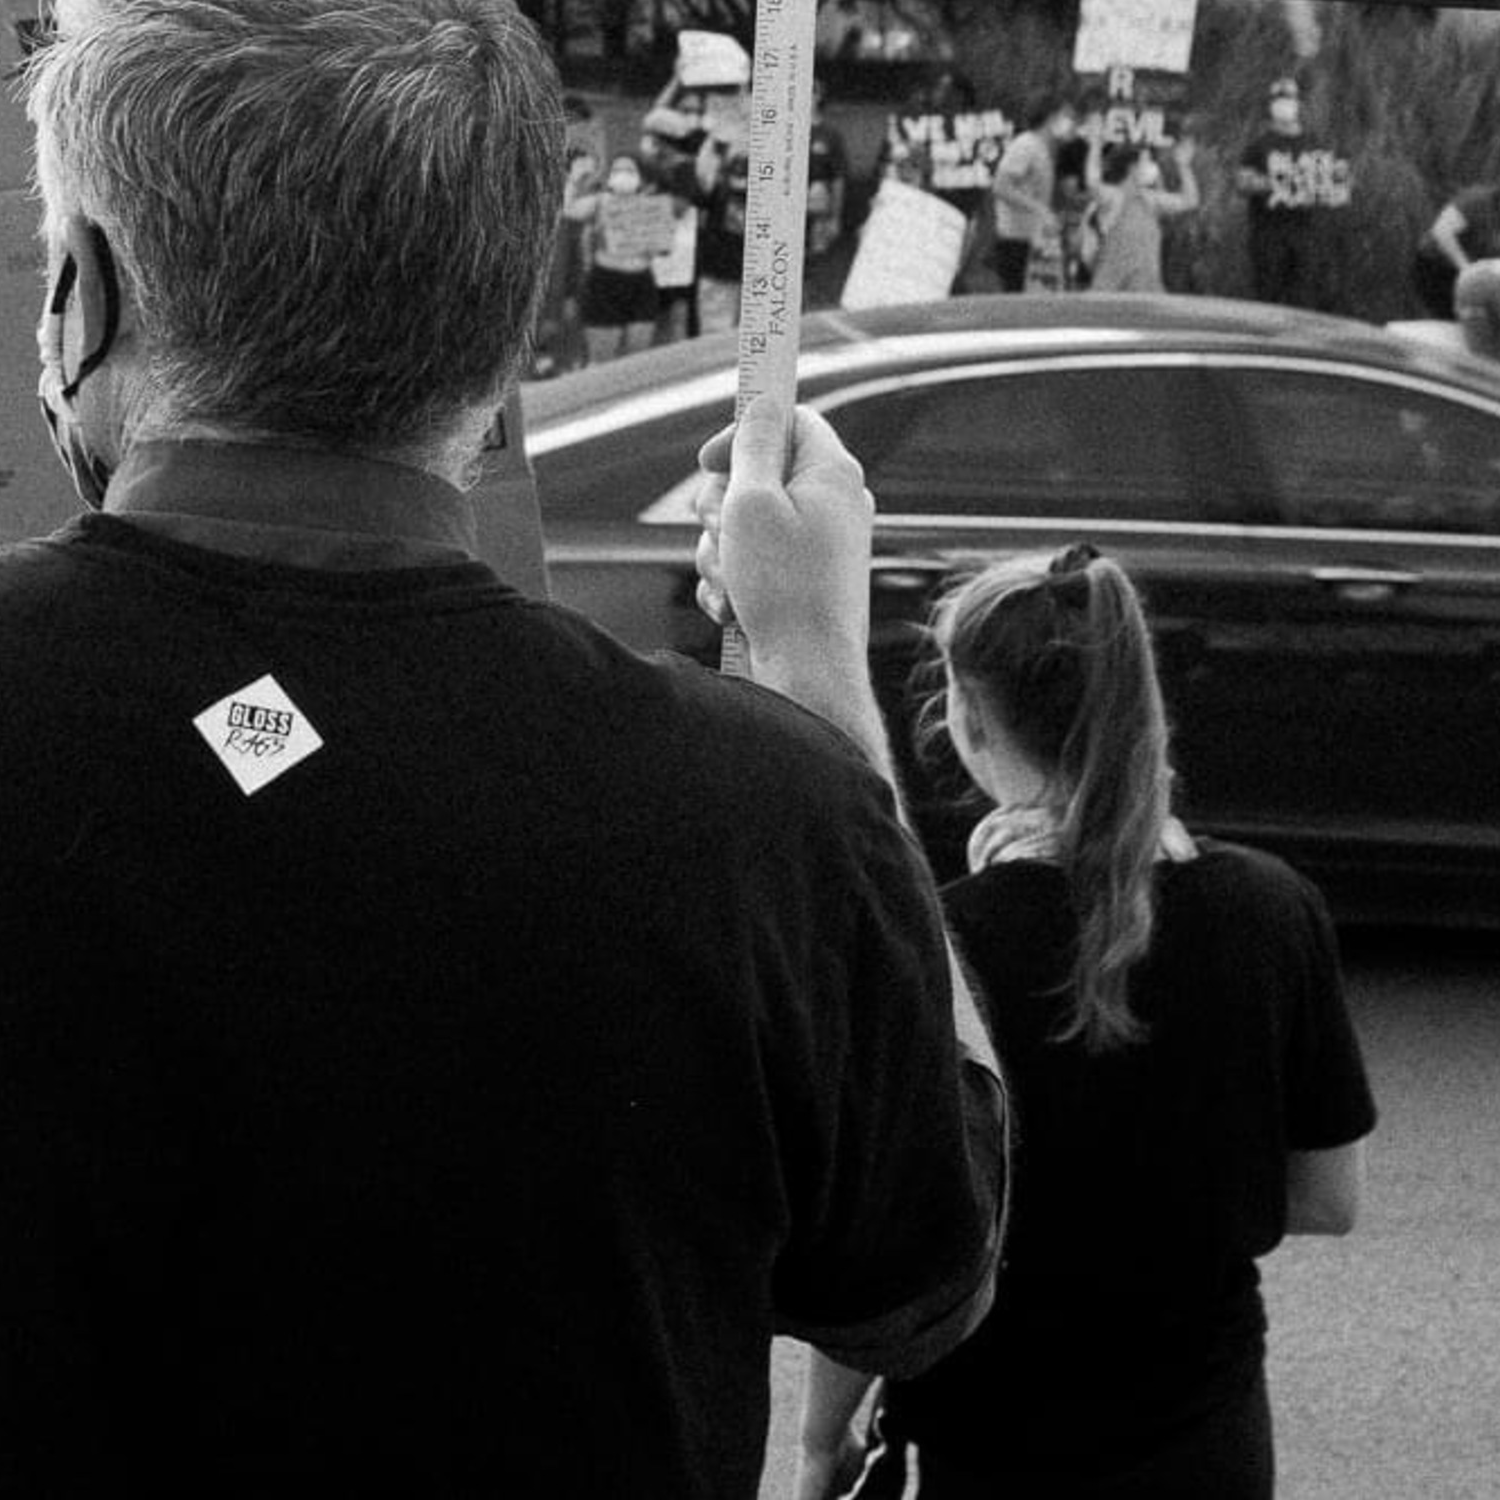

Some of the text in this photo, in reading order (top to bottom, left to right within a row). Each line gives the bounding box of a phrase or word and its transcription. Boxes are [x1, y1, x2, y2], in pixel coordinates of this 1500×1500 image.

[763, 51, 779, 68] 17
[761, 109, 777, 124] 16
[759, 165, 774, 181] 15
[752, 277, 768, 296] 13
[769, 240, 788, 336] FALCON
[750, 336, 766, 353] 12
